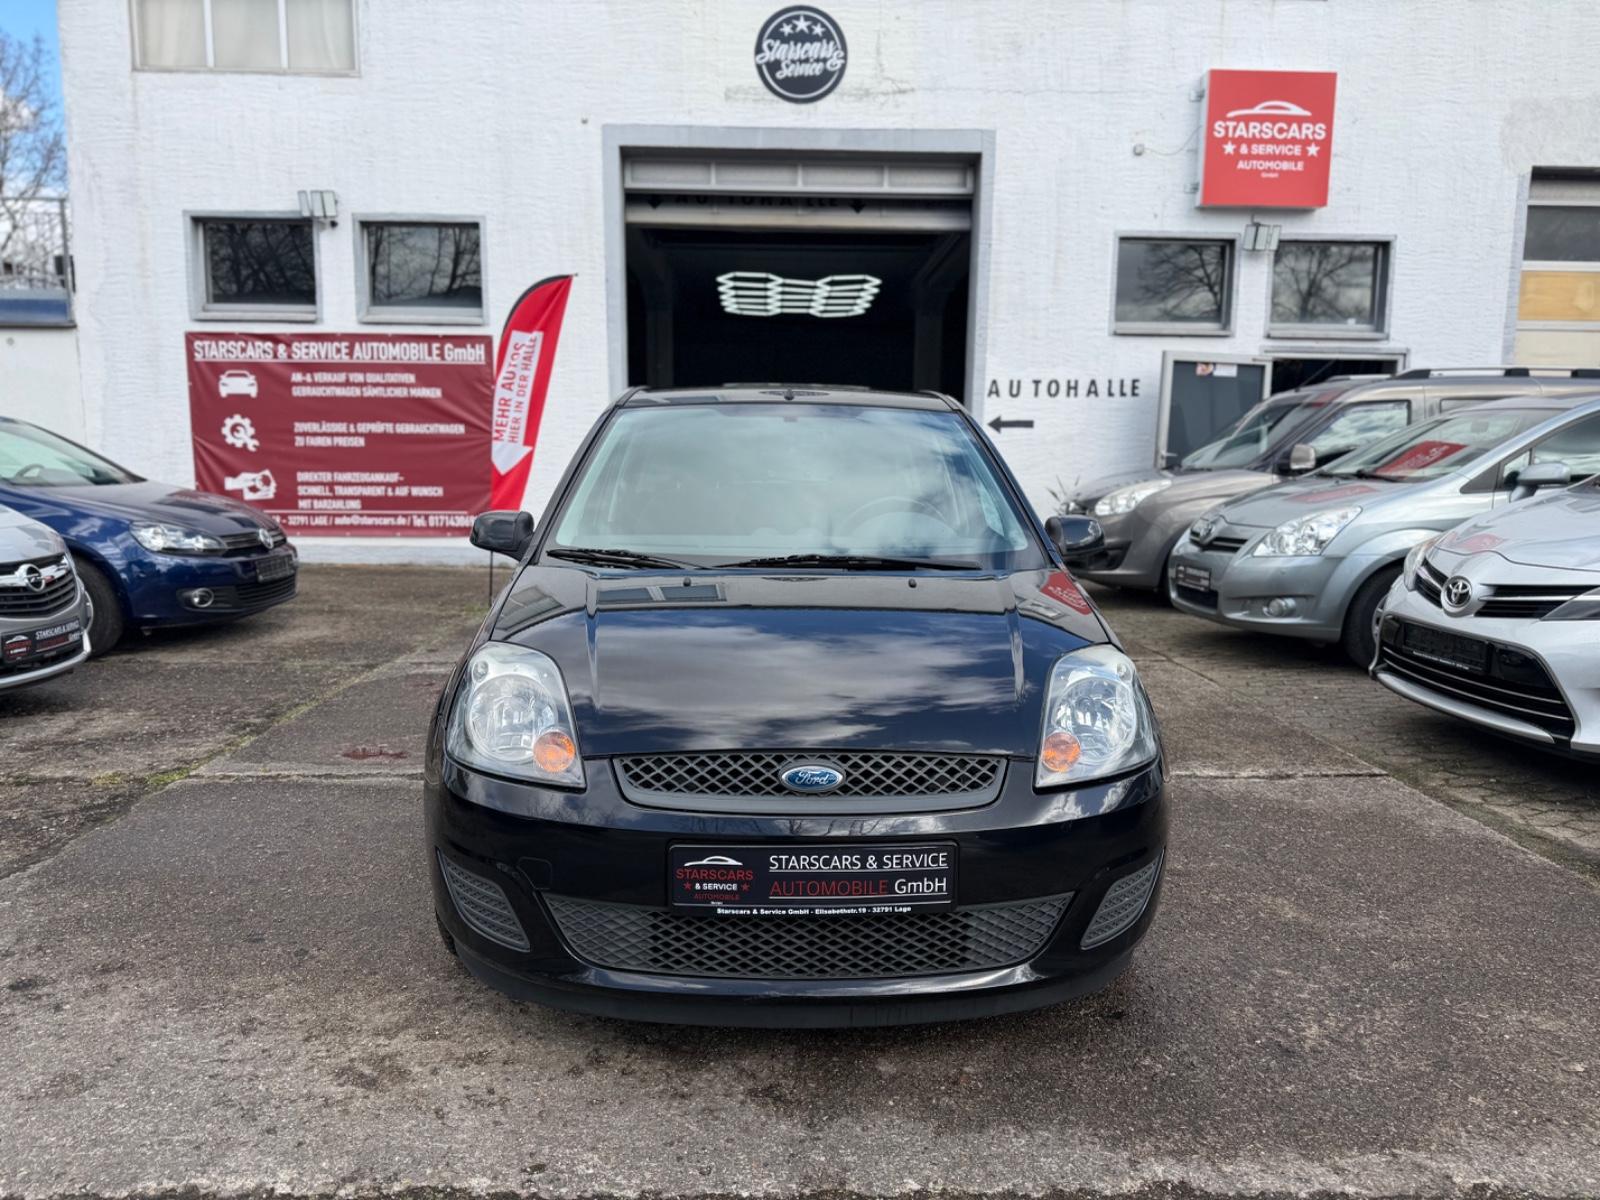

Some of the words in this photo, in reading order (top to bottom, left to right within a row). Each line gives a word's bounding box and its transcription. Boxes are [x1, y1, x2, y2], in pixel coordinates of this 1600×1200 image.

[775, 60, 824, 79] Service
[1213, 120, 1326, 140] STARSCARS
[1239, 143, 1248, 155] &
[1251, 144, 1302, 156] SERVICE
[1237, 160, 1304, 171] AUTOMOBILE
[193, 340, 273, 359] STARSCARS
[277, 343, 288, 359] &
[291, 341, 349, 360] SERVICE
[353, 342, 441, 361] AUTOMOBILE
[444, 343, 485, 361] GmbH
[521, 336, 537, 371] HALLE
[501, 342, 524, 392] AUTOS
[516, 376, 529, 397] DER
[987, 378, 1140, 398] AUTOHALLE
[513, 400, 523, 414] IN
[493, 397, 511, 442] MEHR
[508, 416, 521, 443] HIER
[795, 768, 829, 785] Ford
[769, 856, 861, 870] STARSCARS
[866, 855, 878, 869] &
[883, 852, 948, 868] SERVICE
[675, 868, 753, 881] STARSCARS
[695, 883, 701, 891] &
[703, 883, 738, 891] SERVICE
[769, 880, 888, 896] AUTOMOBILE
[894, 878, 947, 894] GmbH
[717, 907, 751, 915] Starscars
